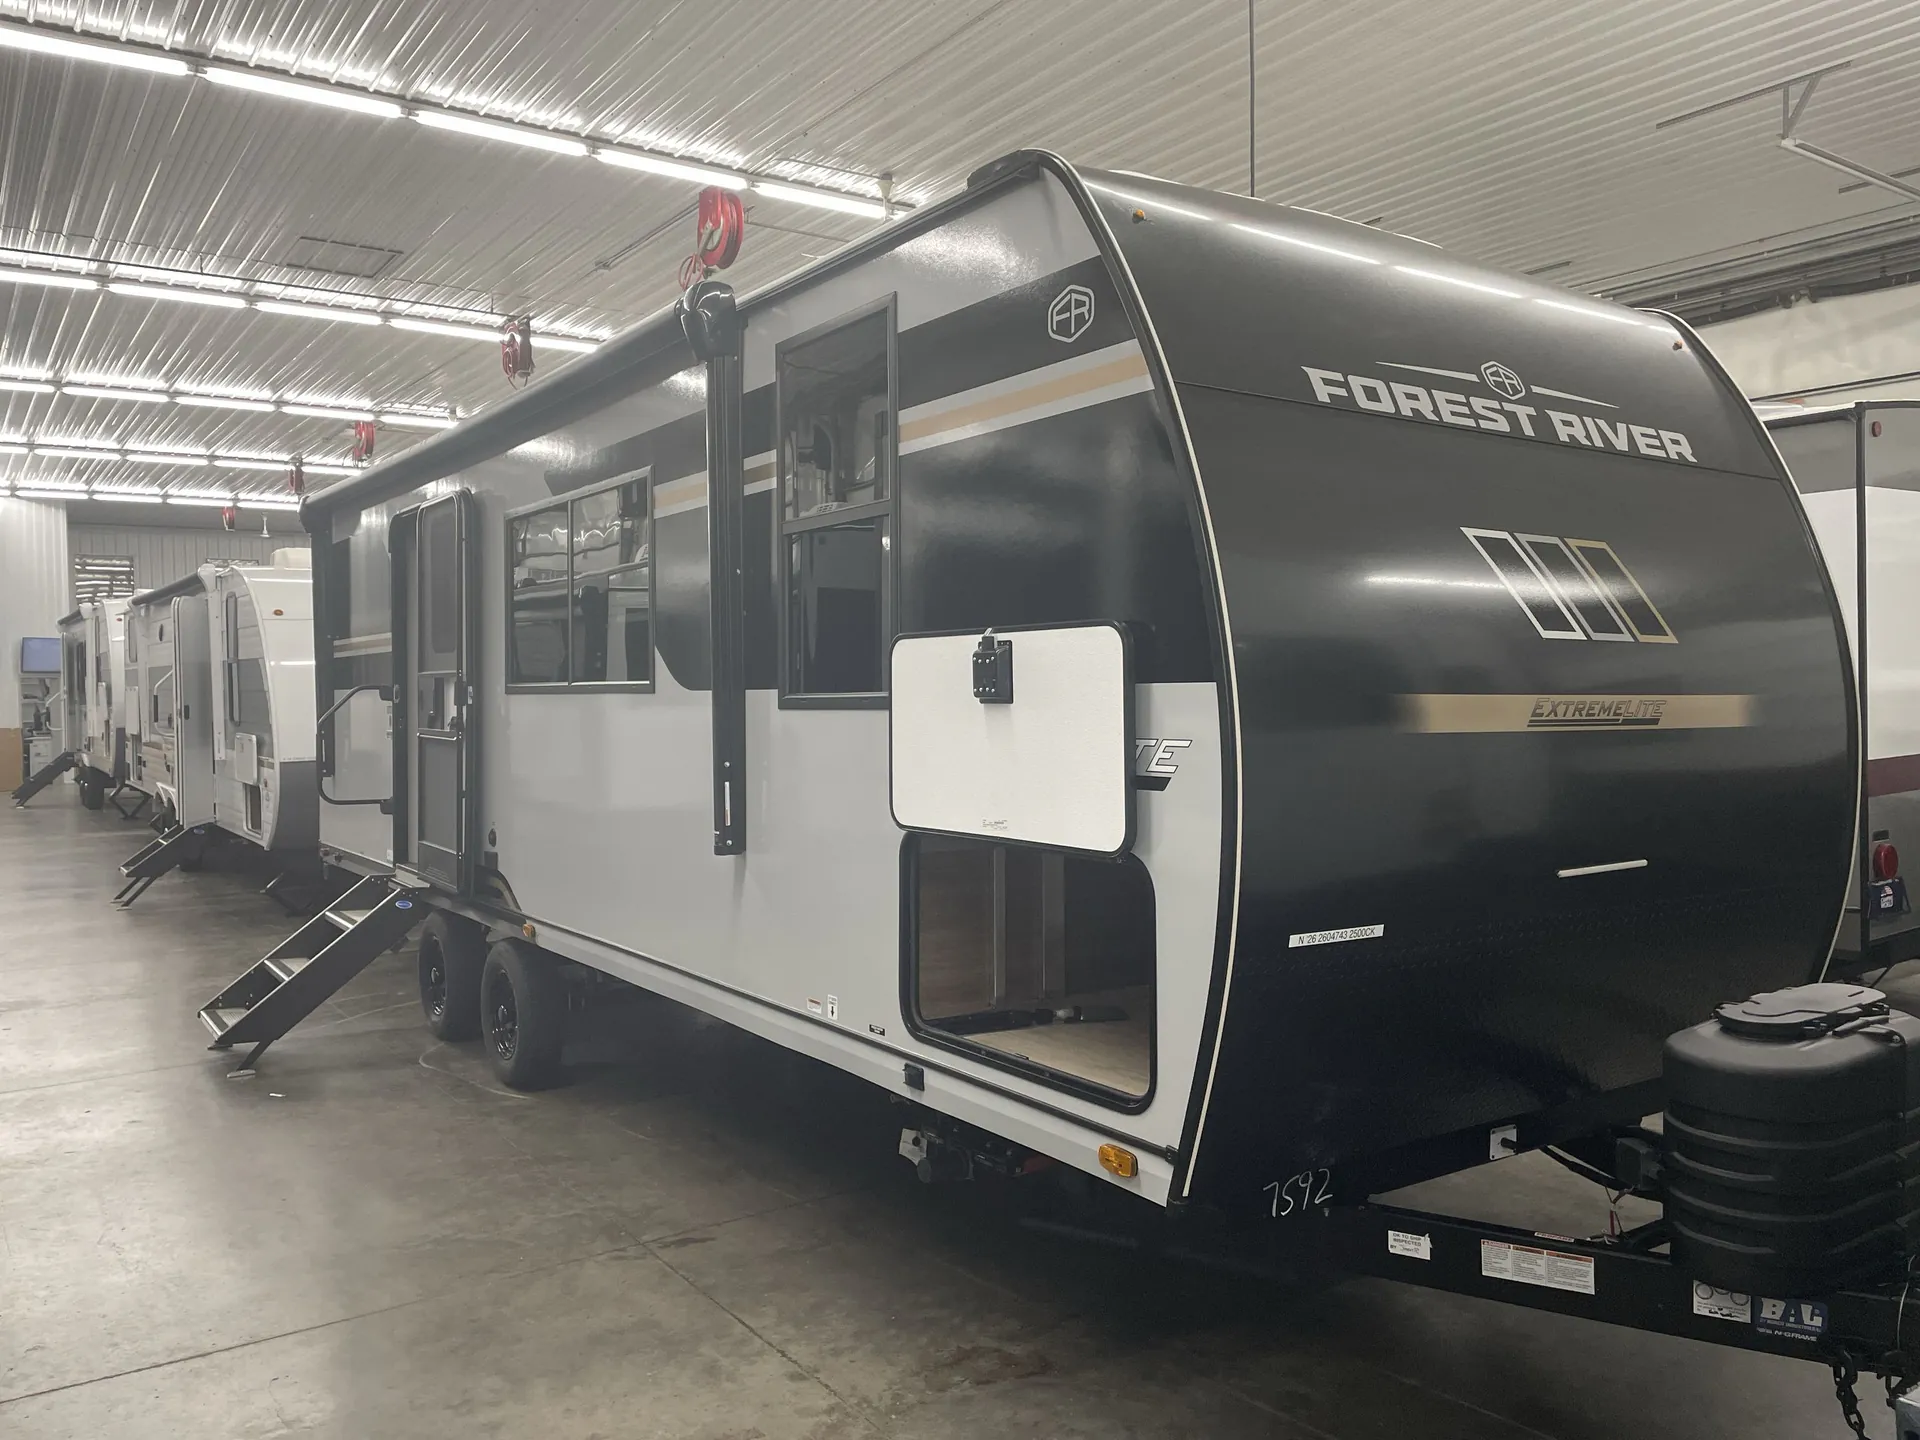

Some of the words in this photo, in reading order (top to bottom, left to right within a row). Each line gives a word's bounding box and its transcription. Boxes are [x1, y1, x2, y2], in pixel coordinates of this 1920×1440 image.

[1301, 366, 1536, 436] FOREST
[1545, 409, 1698, 463] RIVER
[1297, 936, 1305, 945] N
[1317, 930, 1348, 943] 2604743
[1348, 926, 1376, 939] 2500CK
[1262, 1168, 1333, 1218] 7592
